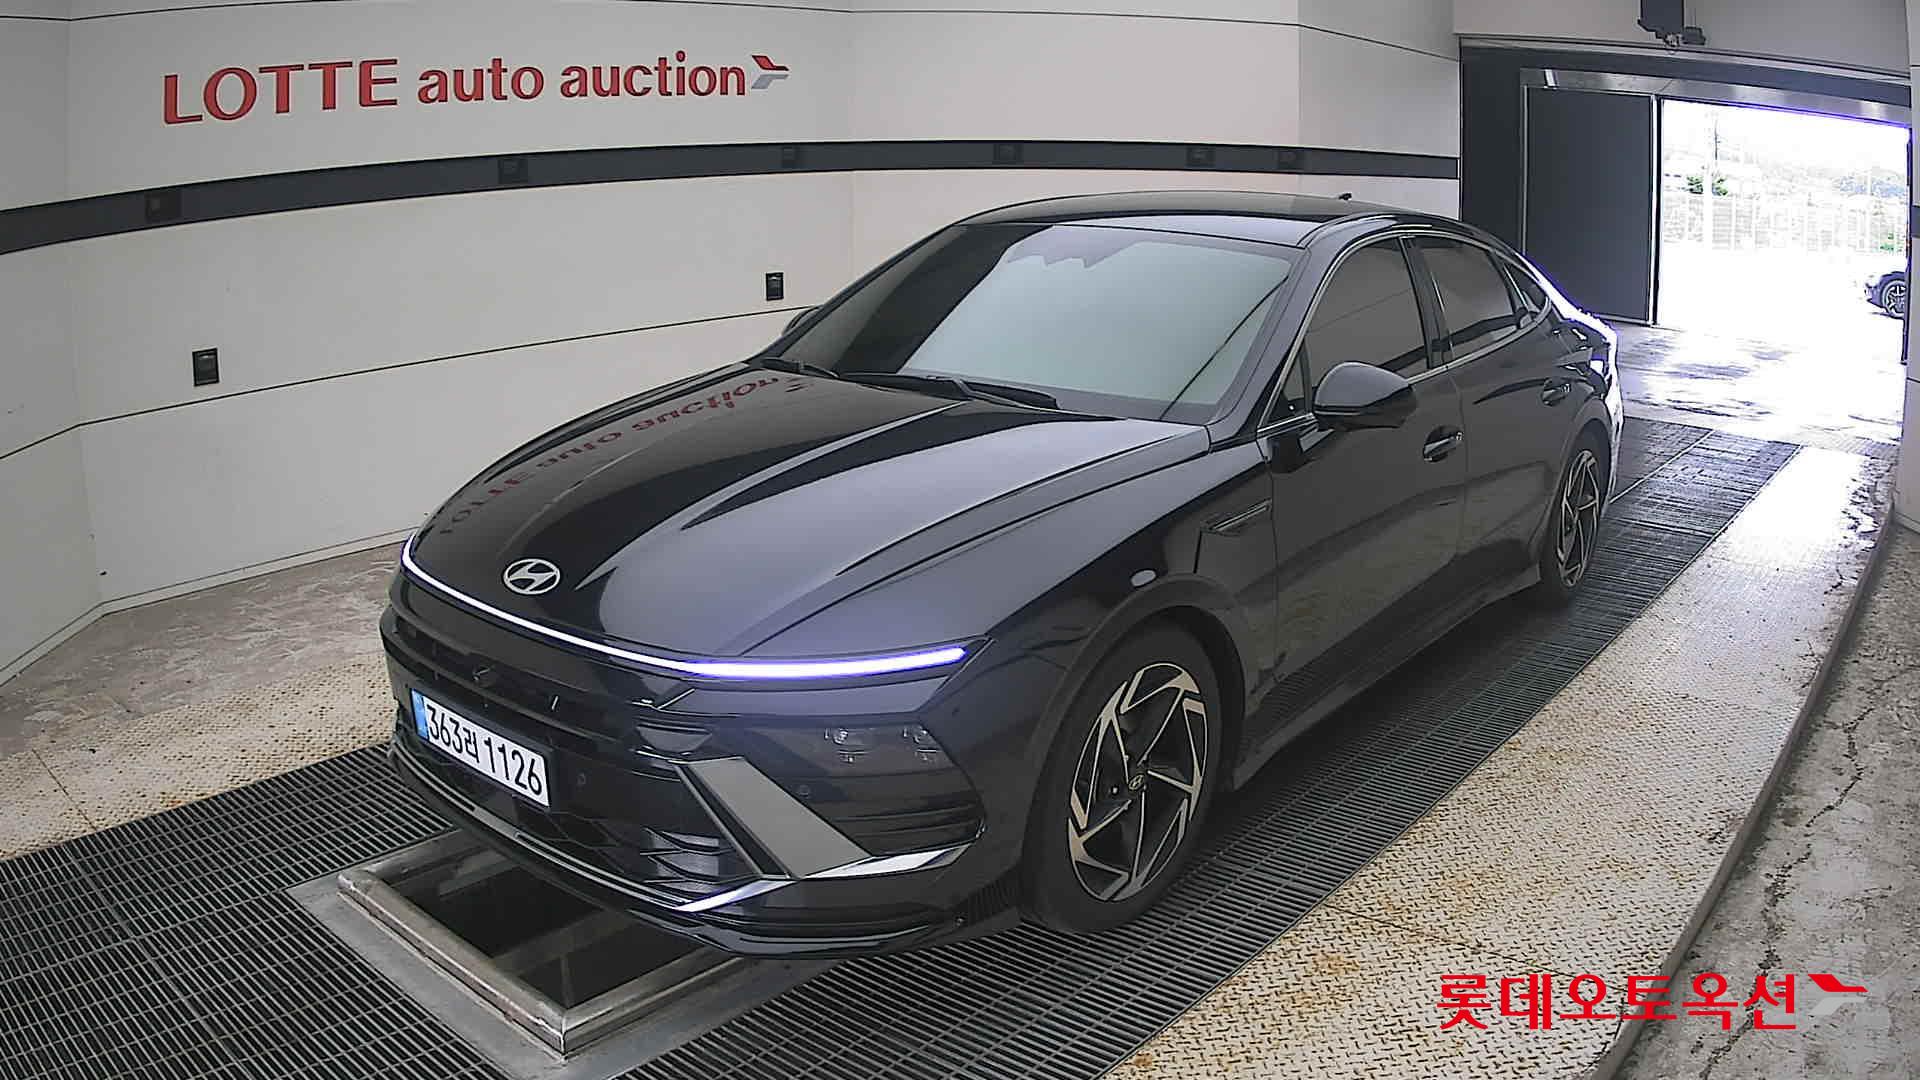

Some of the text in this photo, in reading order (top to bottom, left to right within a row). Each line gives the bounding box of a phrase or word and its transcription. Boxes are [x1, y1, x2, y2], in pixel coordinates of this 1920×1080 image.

[163, 50, 747, 125] LOTTE auto auction
[425, 703, 543, 796] 363러 1126
